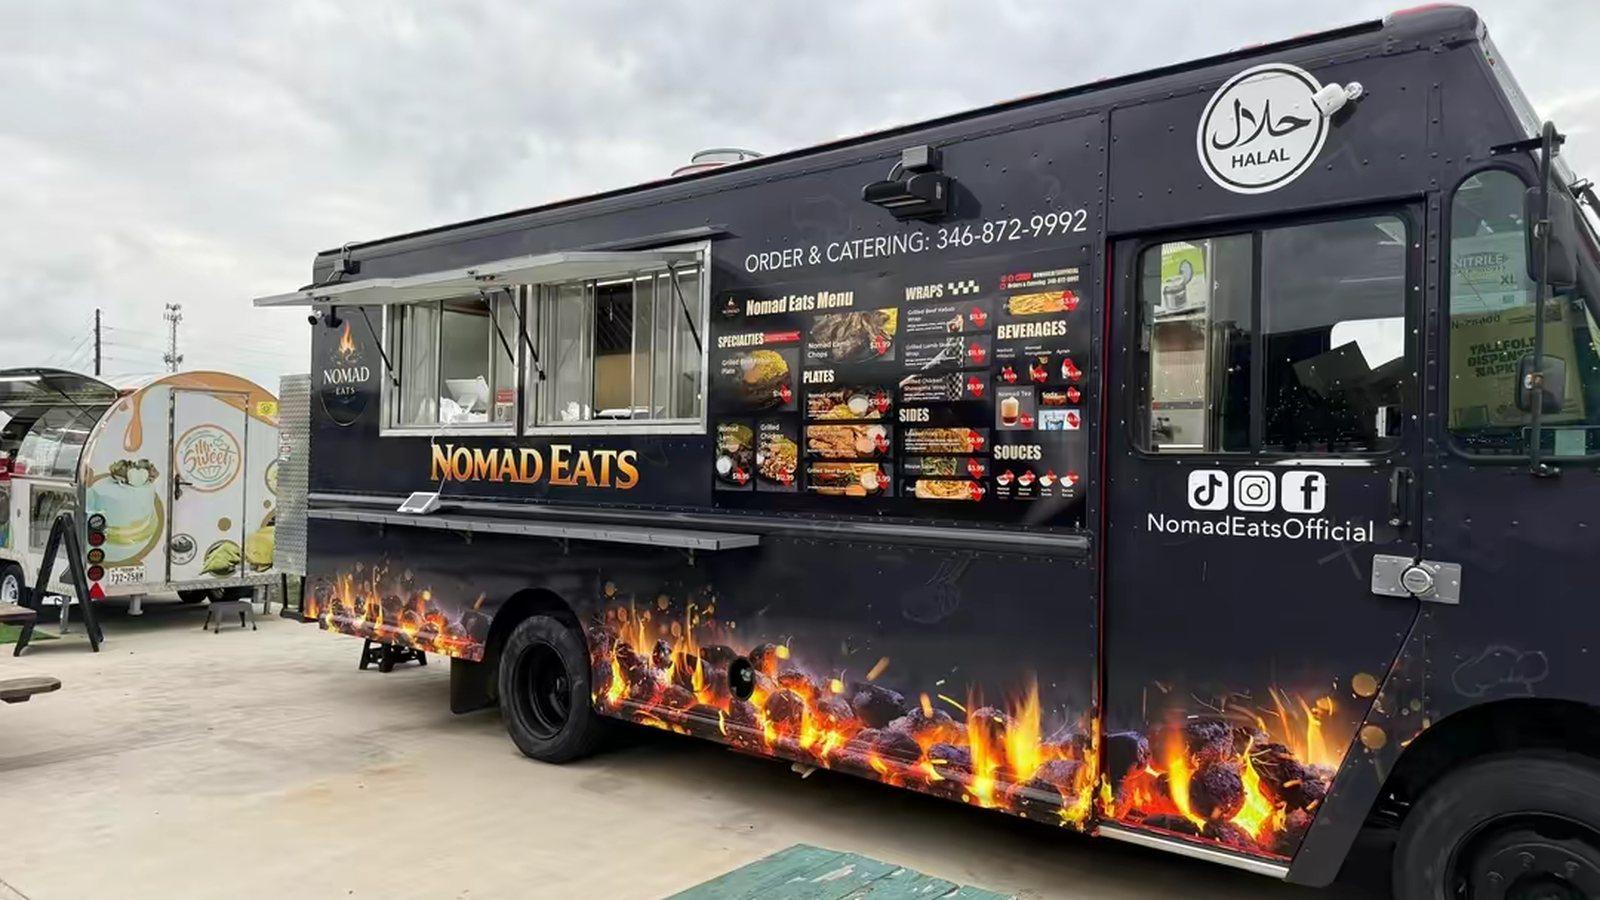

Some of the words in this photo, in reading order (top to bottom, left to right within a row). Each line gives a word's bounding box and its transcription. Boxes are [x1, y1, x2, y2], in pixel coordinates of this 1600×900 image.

[1212, 98, 1312, 150] حلال
[1232, 148, 1290, 168] HALAL
[745, 247, 803, 273] ORDER
[808, 246, 822, 265] &
[826, 231, 930, 263] CATERING:
[936, 209, 1088, 250] 346-872-9992
[905, 283, 943, 301] WRAPS
[746, 296, 787, 316] Nomad
[789, 294, 814, 312] Eats
[817, 291, 853, 309] Menu
[997, 320, 1067, 340] BEVERAGES
[717, 332, 765, 349] SPECIALTIES
[807, 350, 828, 359] Chops
[323, 366, 370, 385] NOMAD
[803, 369, 834, 384] PLATES
[336, 386, 355, 396] EATS
[899, 407, 930, 423] SIDES
[994, 444, 1042, 460] SOUCES
[1147, 513, 1375, 543] NomadEatsOfficial
